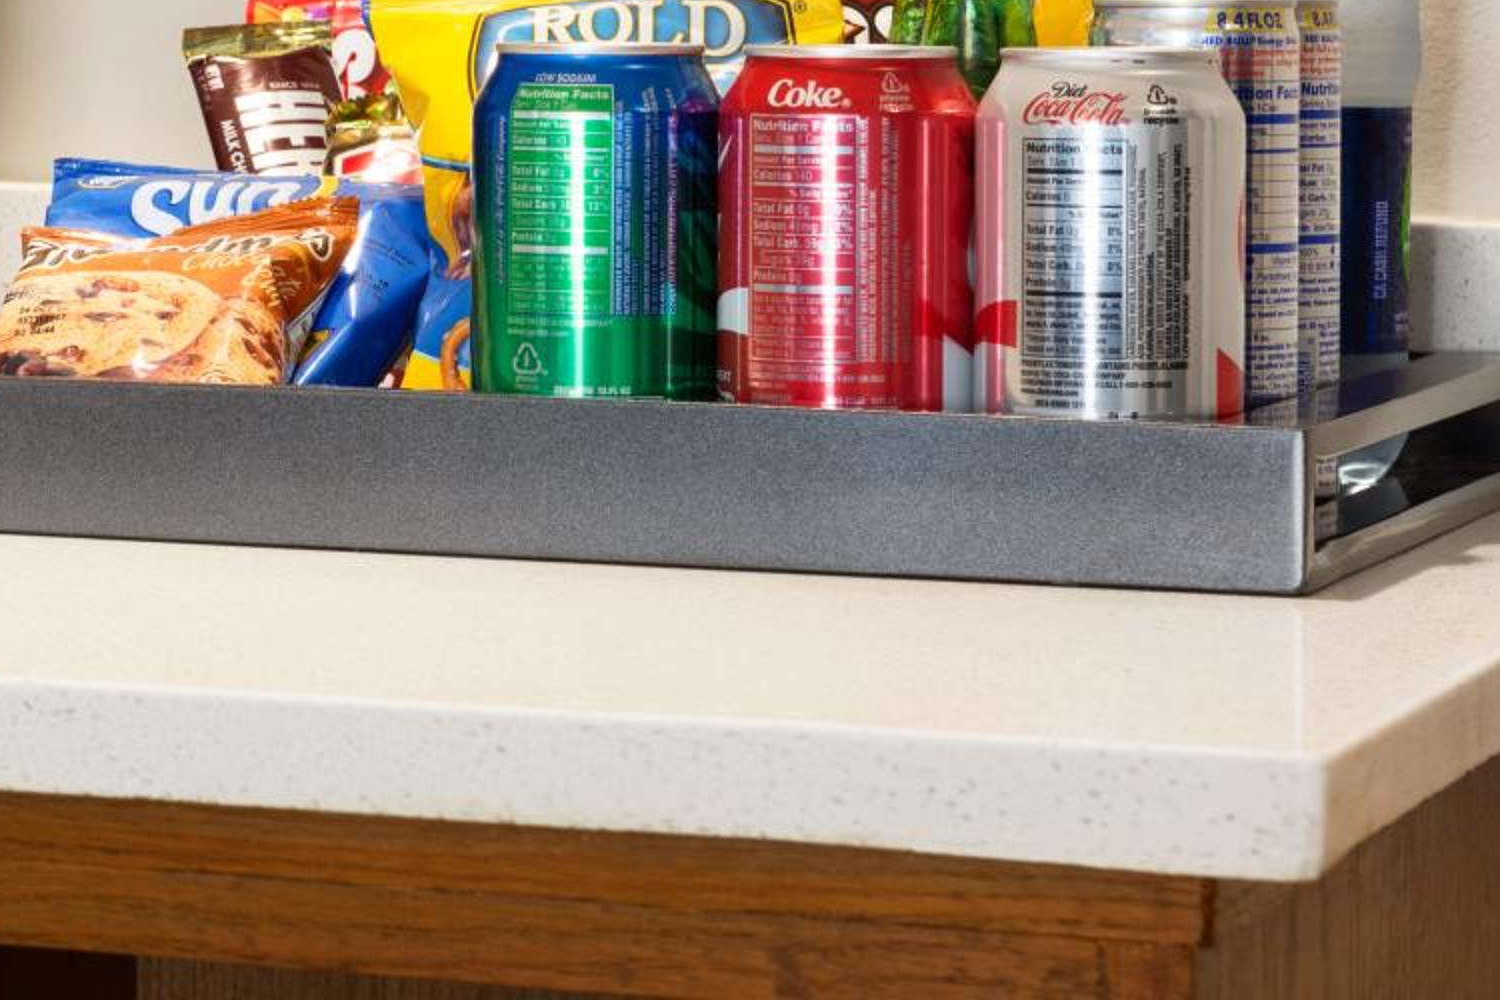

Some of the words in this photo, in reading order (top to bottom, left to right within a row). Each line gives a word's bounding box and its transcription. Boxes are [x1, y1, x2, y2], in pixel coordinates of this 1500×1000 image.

[557, 73, 597, 83] SODIUM
[516, 87, 570, 99] Nutrition
[573, 88, 609, 100] Facts
[767, 78, 843, 108] Coke
[1051, 81, 1088, 98] Diet
[753, 120, 809, 133] Nutrition
[219, 119, 243, 153] MILK
[1027, 141, 1080, 154] Nutrition
